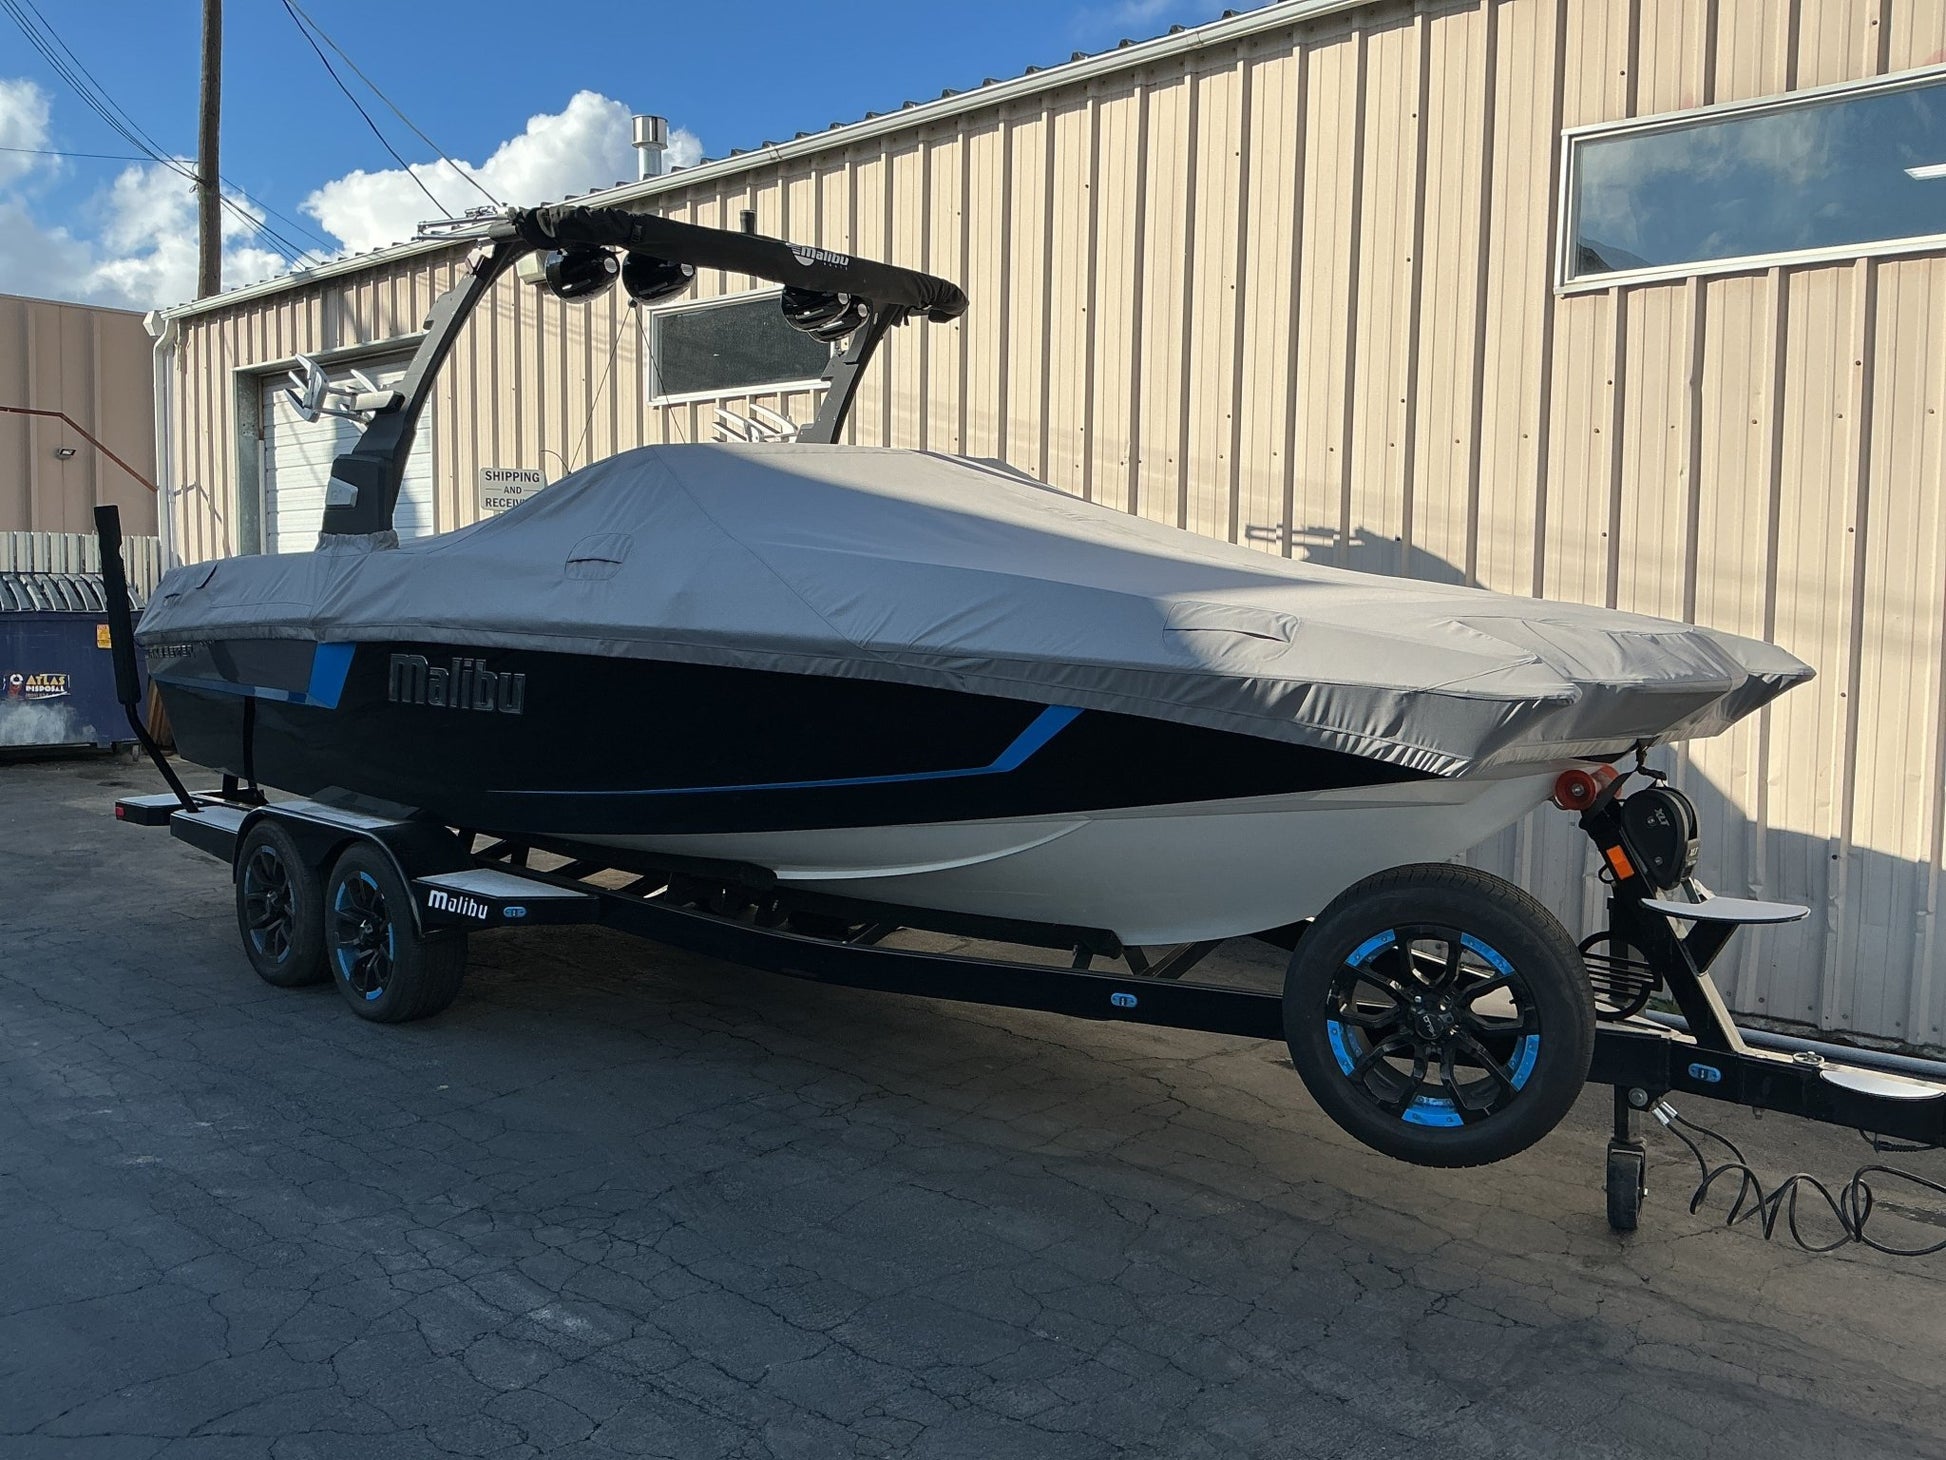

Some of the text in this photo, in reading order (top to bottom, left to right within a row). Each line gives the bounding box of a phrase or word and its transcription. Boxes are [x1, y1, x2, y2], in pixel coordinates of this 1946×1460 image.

[485, 470, 540, 482] SHIPPING
[503, 486, 522, 495] AND
[485, 497, 526, 508] RECEIV
[26, 674, 66, 686] ATLAS
[1654, 808, 1671, 827] XLT
[427, 889, 489, 920] Malibu
